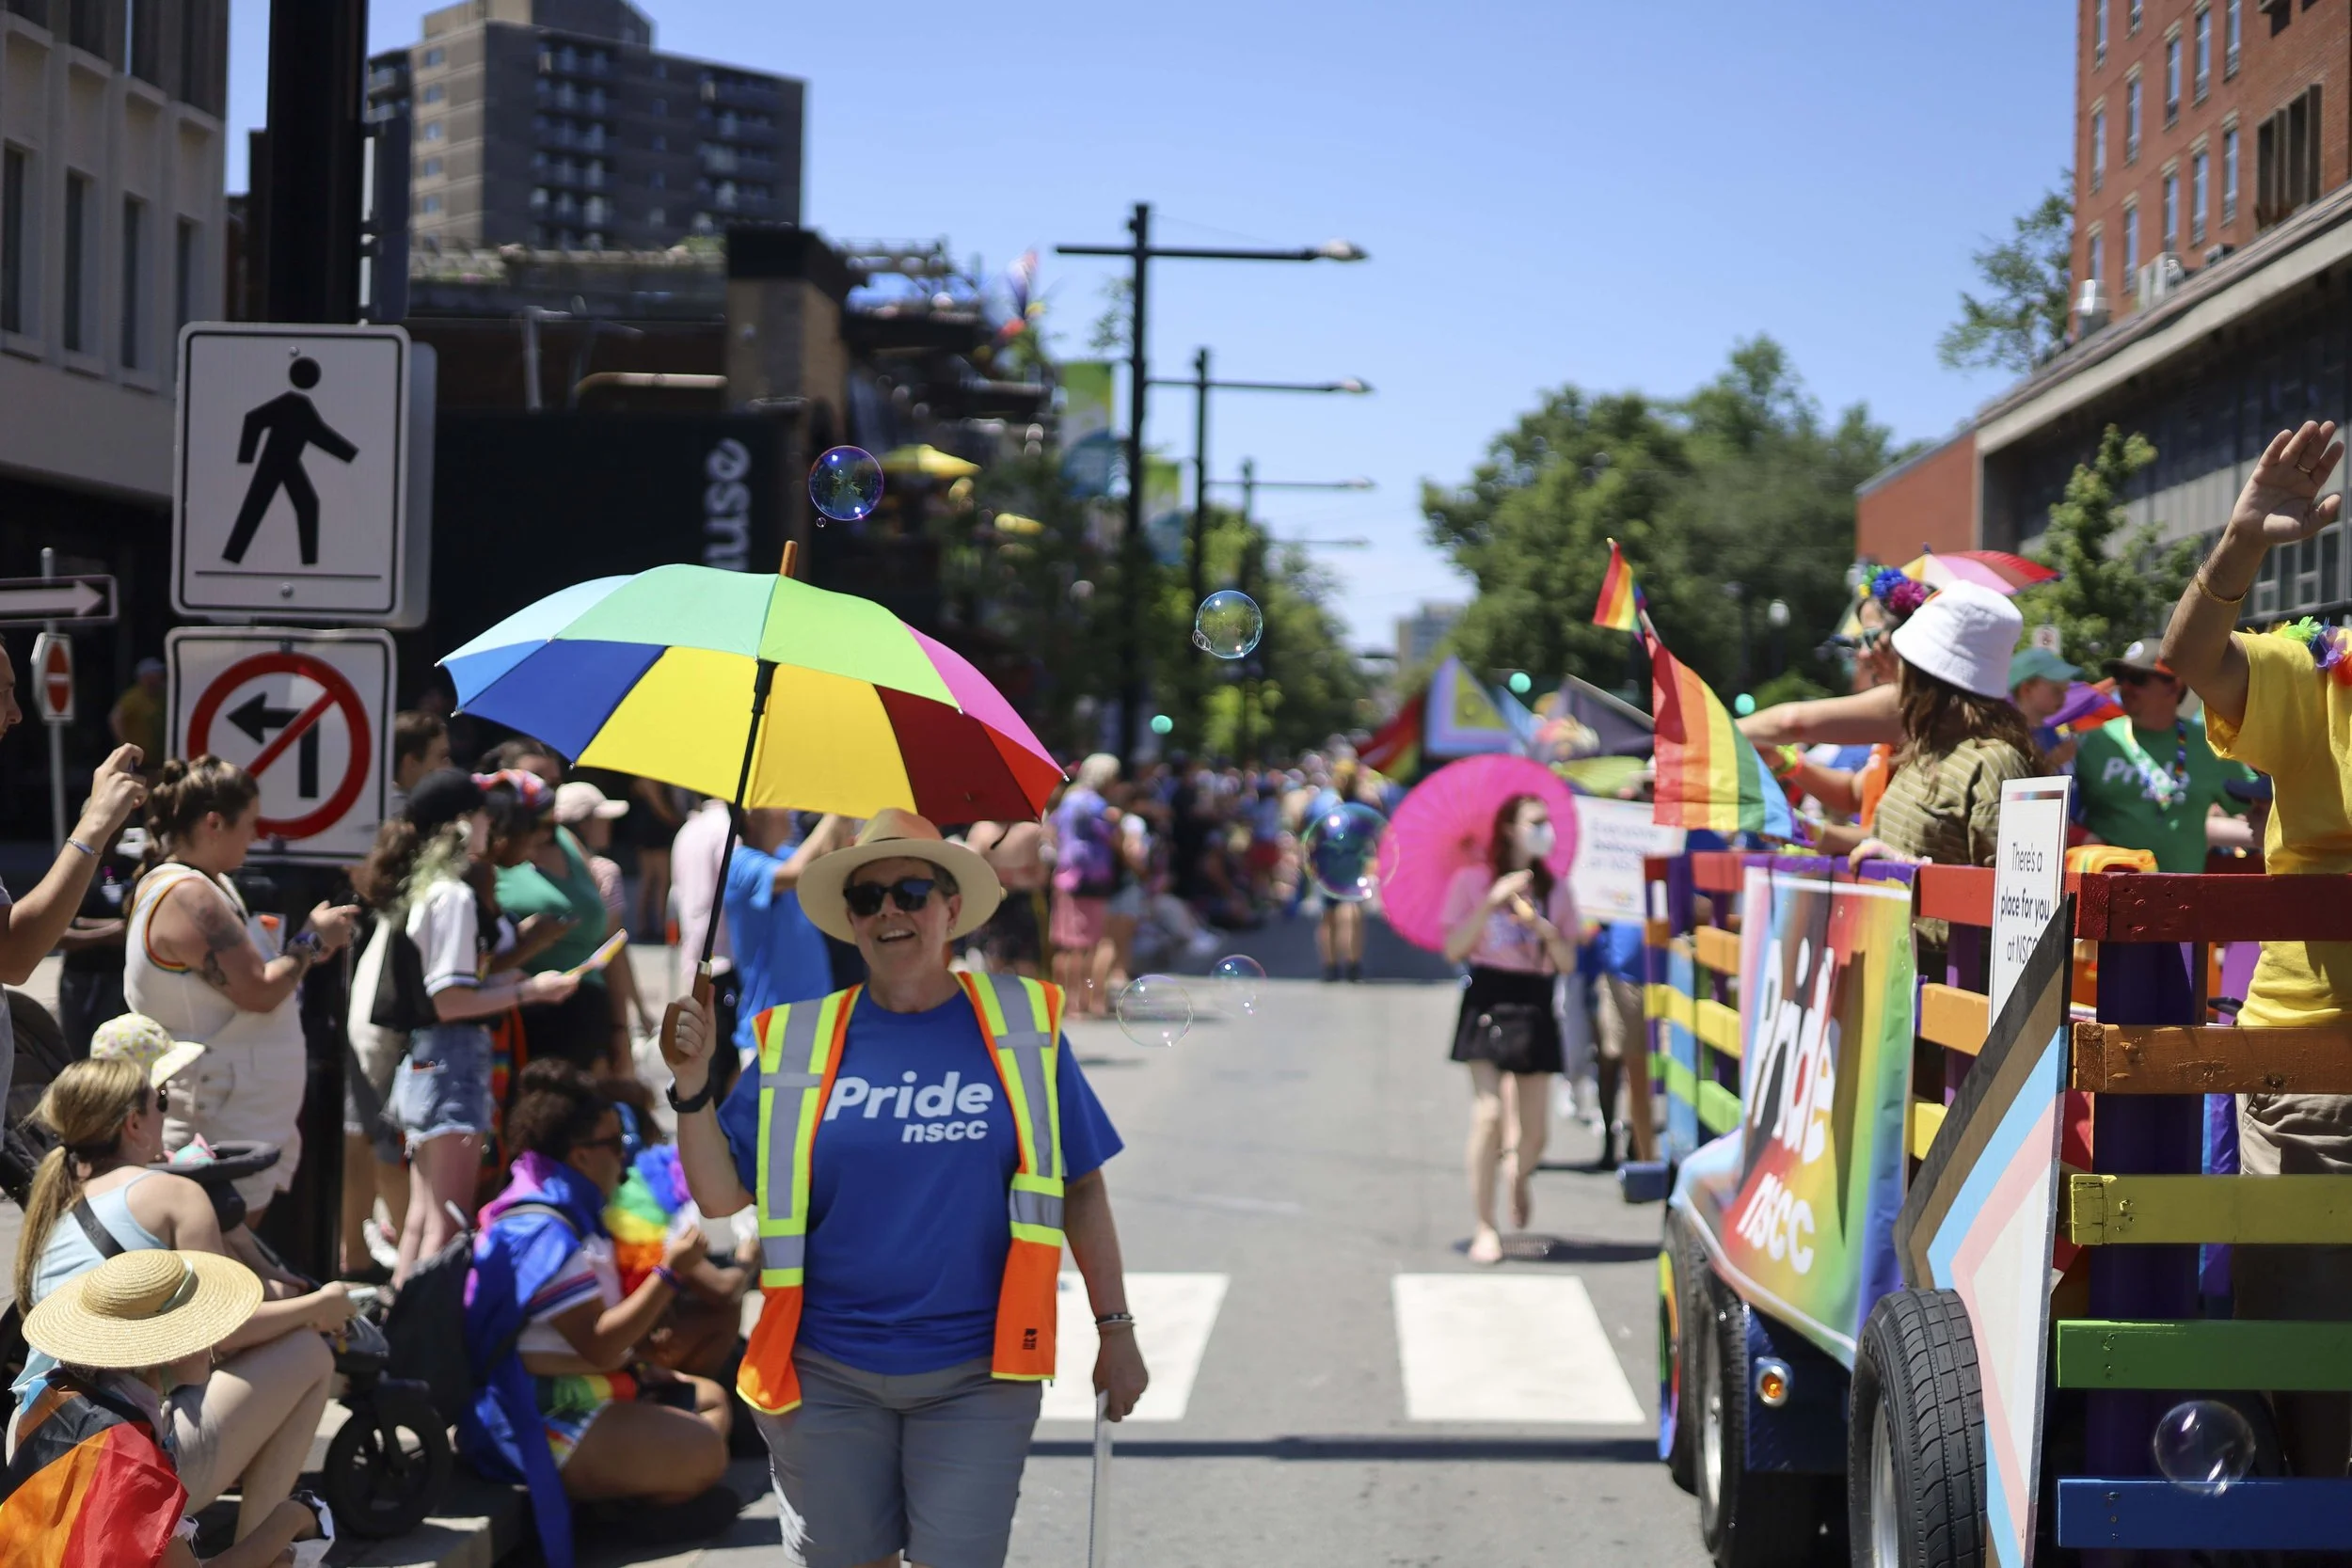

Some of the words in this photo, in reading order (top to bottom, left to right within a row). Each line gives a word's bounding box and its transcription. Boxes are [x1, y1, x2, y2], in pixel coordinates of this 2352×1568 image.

[2011, 842, 2035, 873] There's
[2037, 850, 2042, 873] a
[2000, 885, 2020, 922] place
[2021, 887, 2033, 919] for
[2034, 898, 2050, 927] you
[2007, 936, 2014, 962] at
[1745, 937, 1836, 1164] Pride
[822, 1070, 993, 1122] Pride
[900, 1119, 989, 1144] nscc
[1736, 1172, 1815, 1275] nscc
